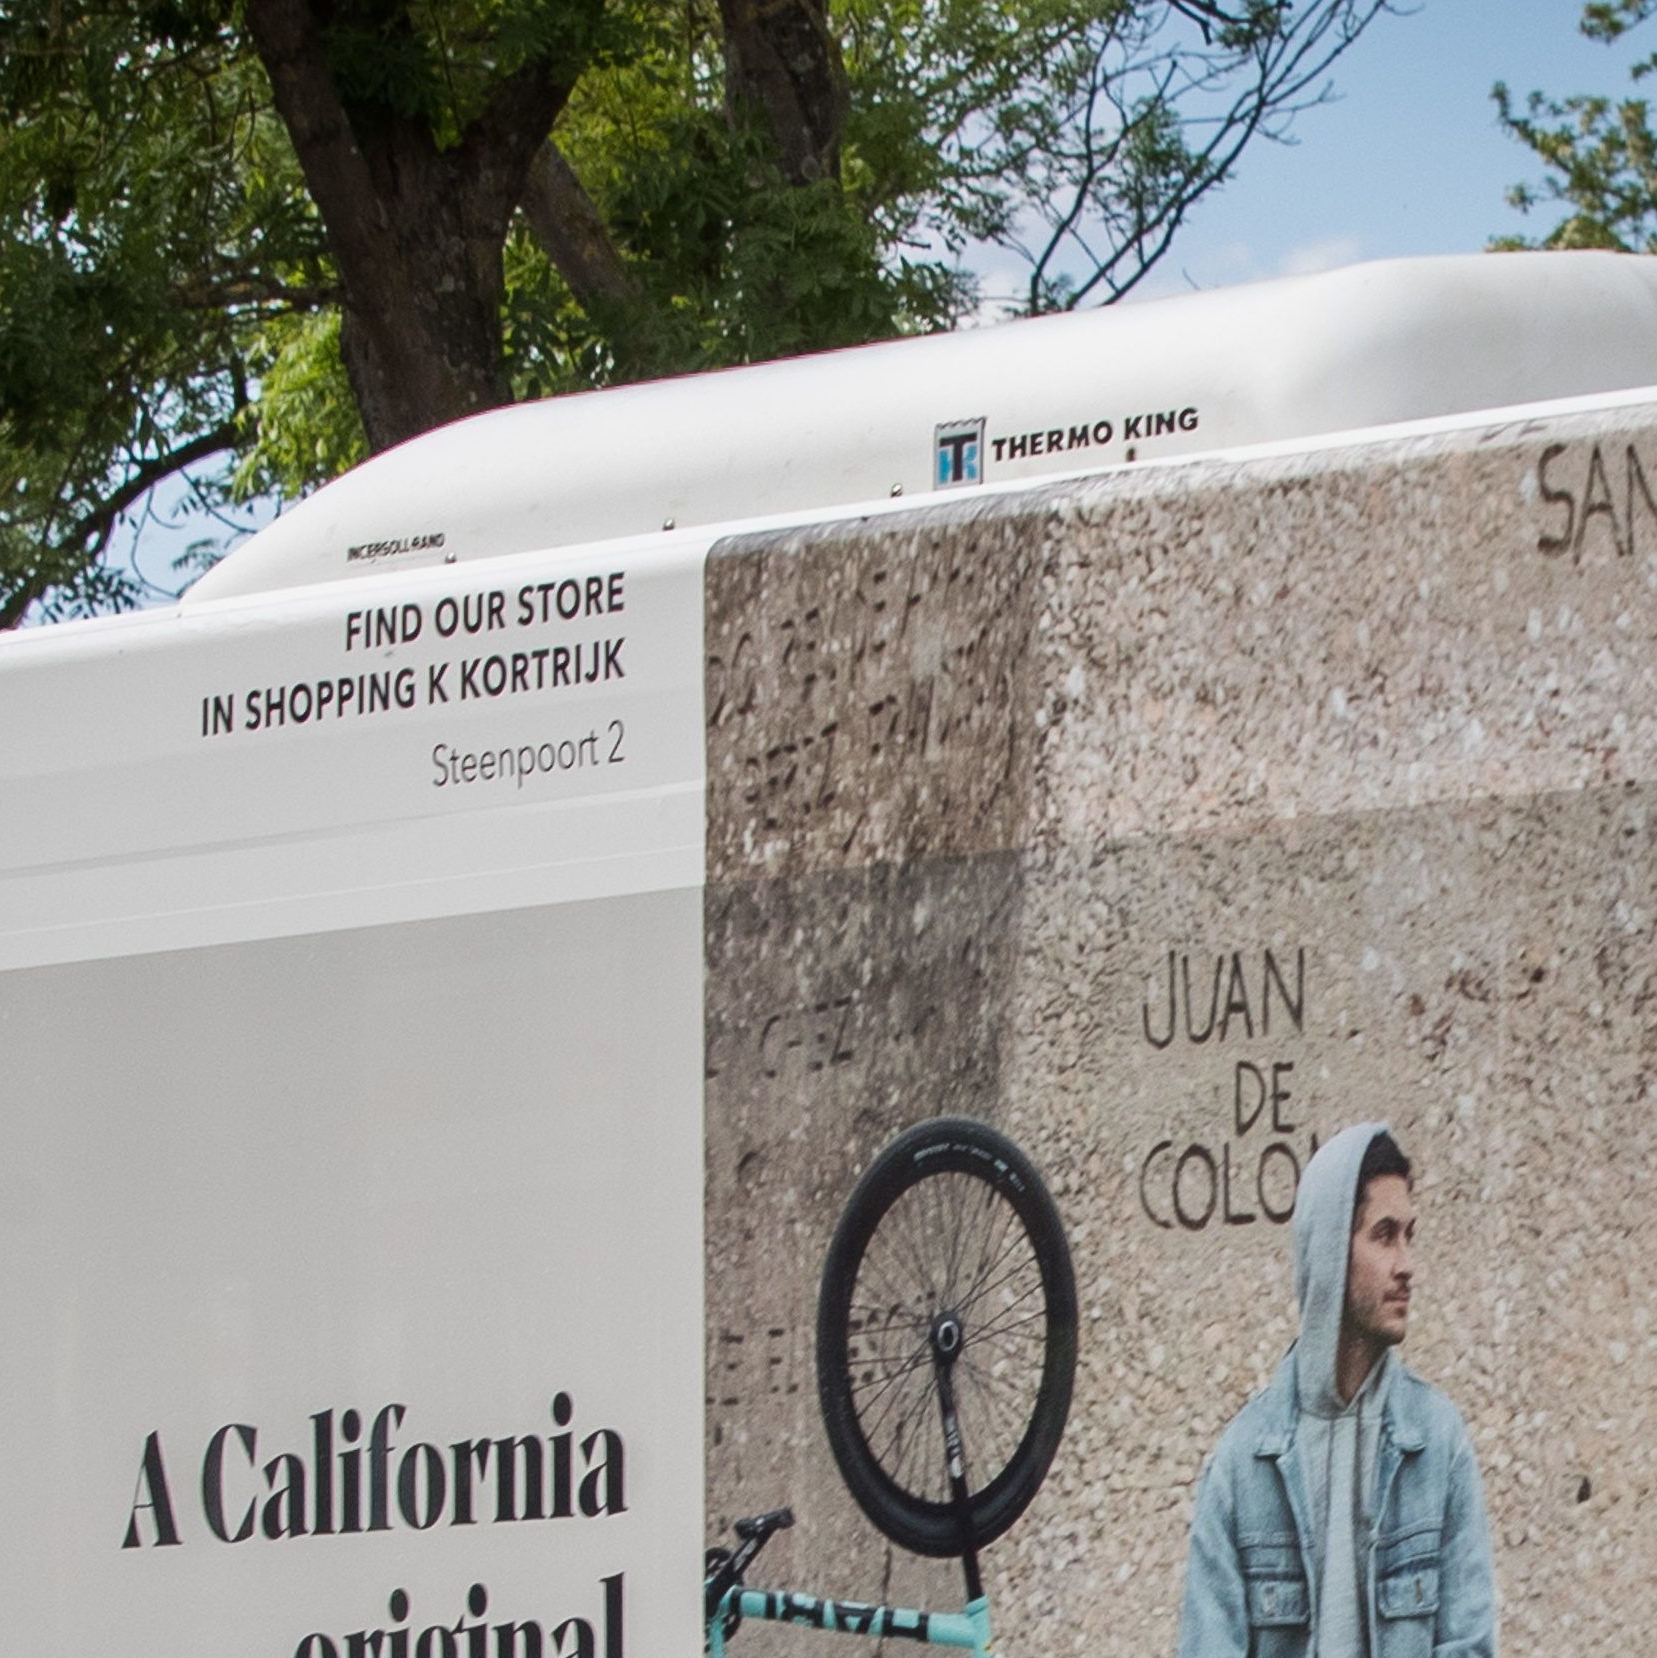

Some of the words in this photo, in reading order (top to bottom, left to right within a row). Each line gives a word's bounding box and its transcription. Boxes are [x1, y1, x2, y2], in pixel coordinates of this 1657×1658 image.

[991, 421, 1113, 462] THERMO
[1123, 407, 1199, 441] KING
[346, 603, 423, 651] FIND
[435, 590, 506, 637] OUR
[517, 572, 625, 627] STORE
[201, 694, 235, 737] IN
[245, 667, 416, 731] SHOPPING
[428, 662, 450, 704] K
[461, 637, 625, 701] KORTRIJK
[432, 729, 600, 789] Steenpoort
[607, 718, 626, 764] 2
[1142, 948, 1304, 1049] JUAN
[1235, 1061, 1295, 1137] DE
[1140, 1132, 1318, 1232] COLO
[121, 1429, 184, 1550] A
[201, 1390, 629, 1543] California
